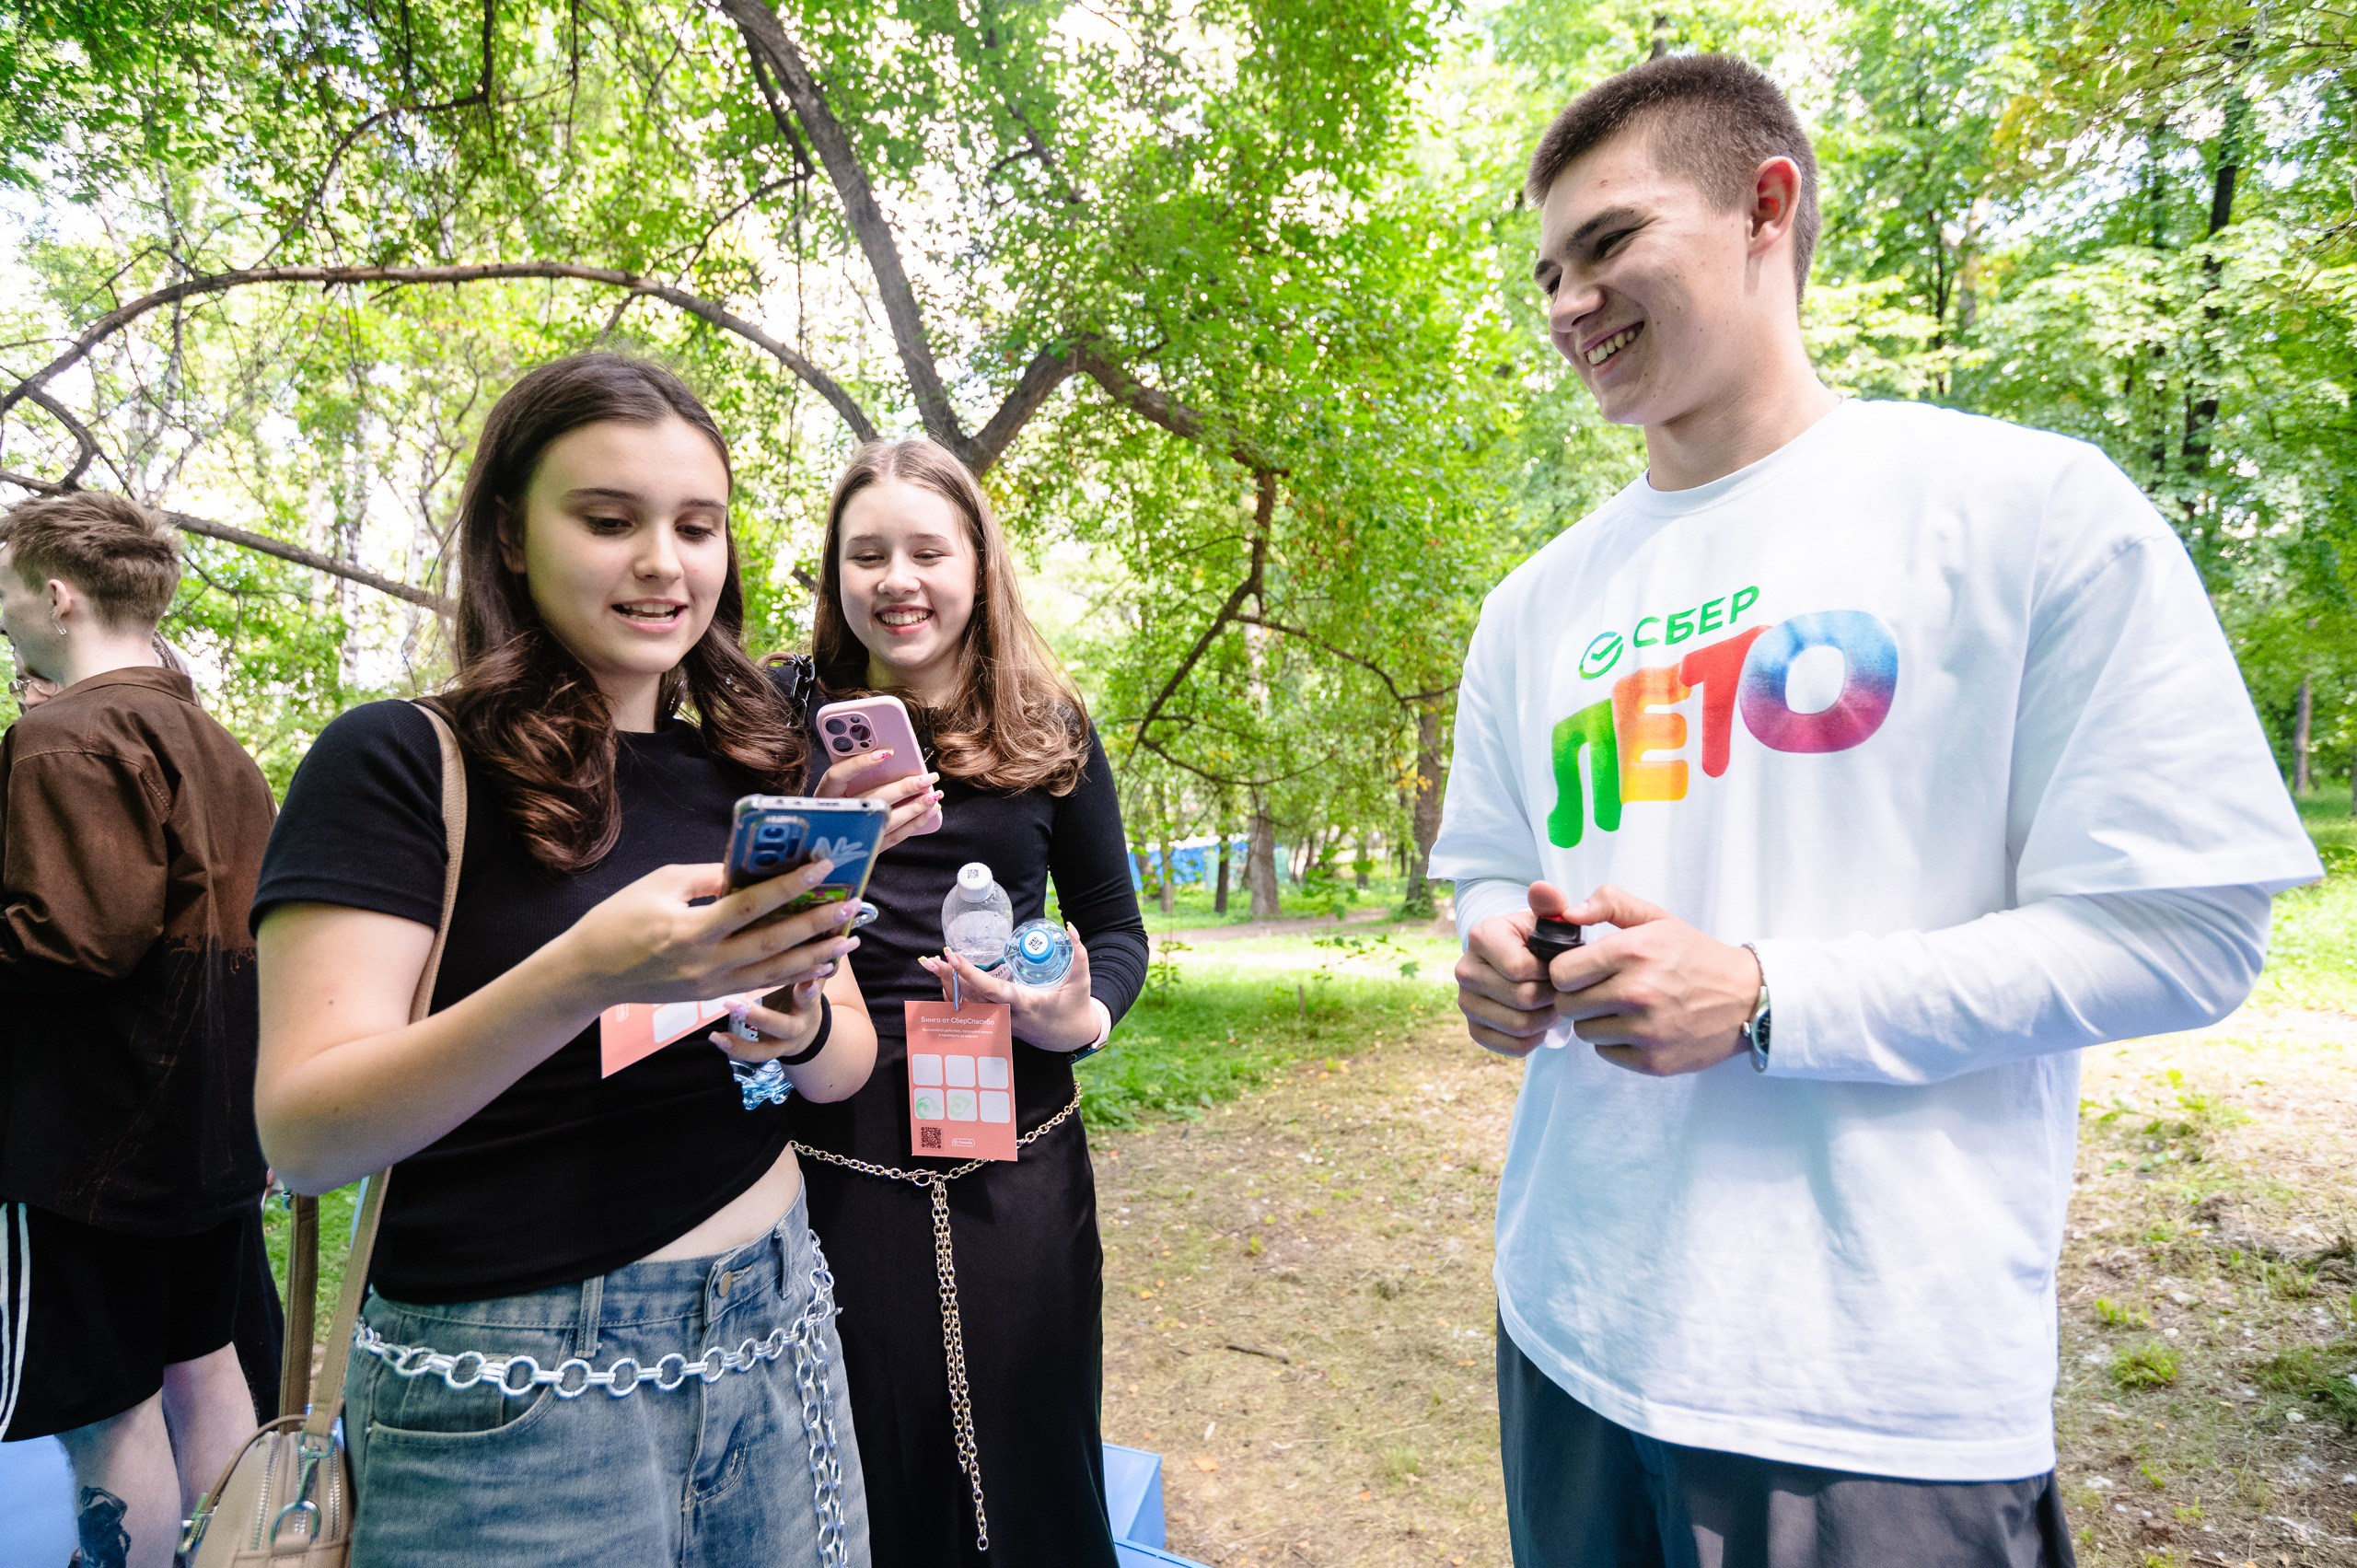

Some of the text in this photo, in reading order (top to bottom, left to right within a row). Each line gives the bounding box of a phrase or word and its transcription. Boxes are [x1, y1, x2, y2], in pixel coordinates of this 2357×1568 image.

[1632, 586, 1760, 648] СБЕР
[1547, 610, 1899, 849] ЛЕТО
[950, 1017, 995, 1026] СберСпасибо
